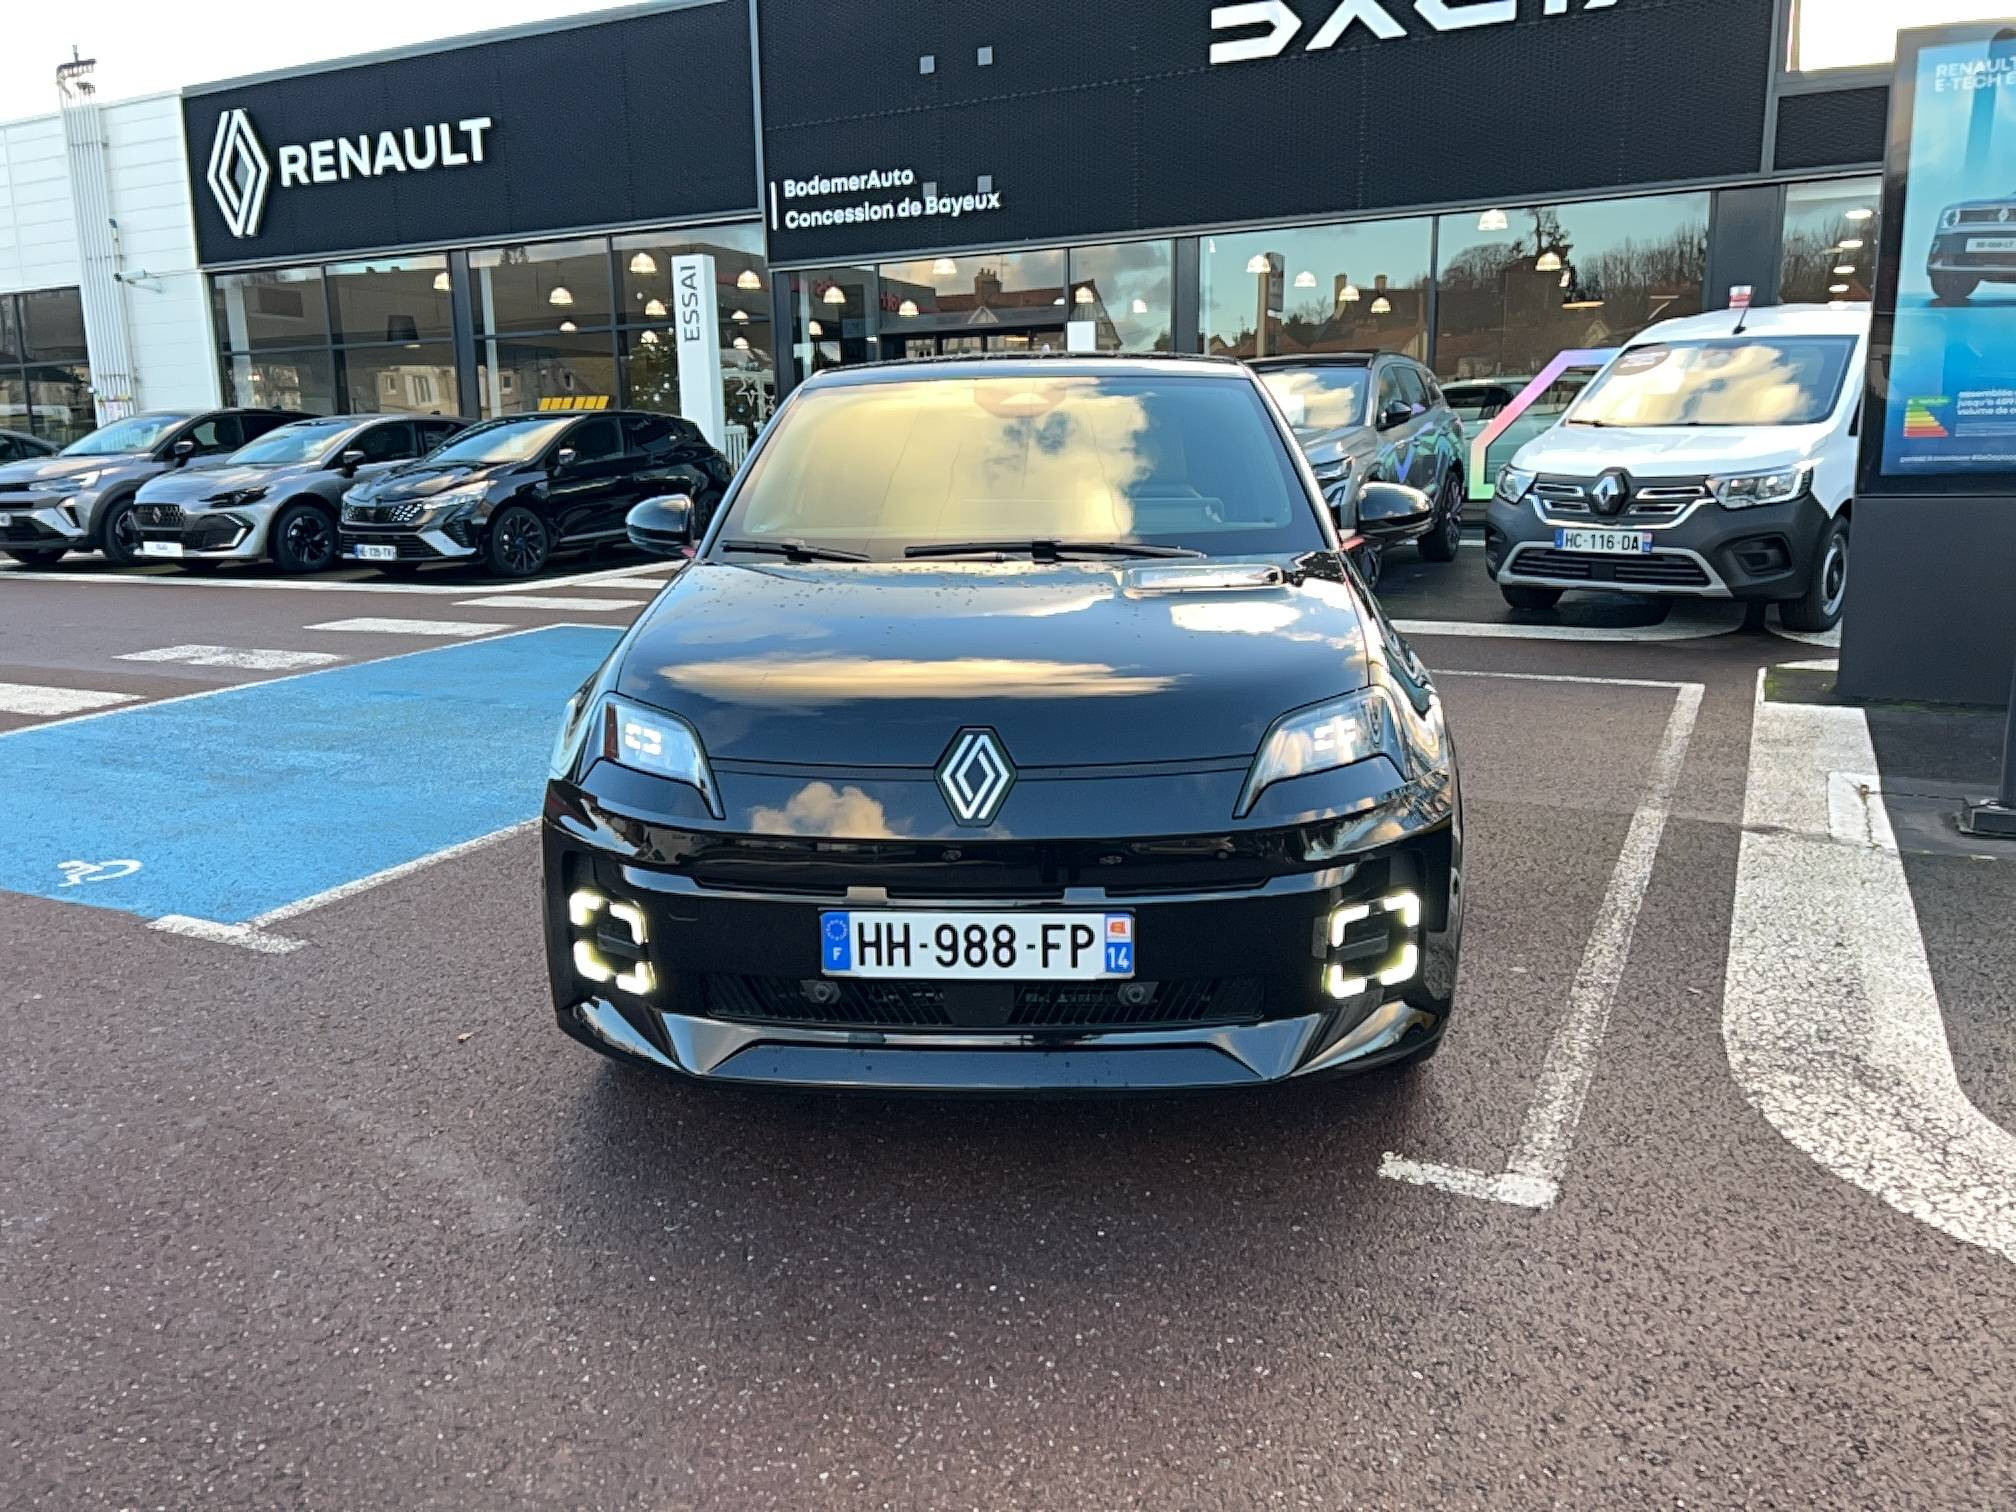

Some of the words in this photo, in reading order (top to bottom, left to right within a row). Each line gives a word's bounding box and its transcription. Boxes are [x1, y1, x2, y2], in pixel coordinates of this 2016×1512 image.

[279, 117, 492, 188] RENAULT
[783, 169, 914, 198] BodemerAuto
[785, 200, 894, 229] Concession
[897, 197, 922, 217] de
[924, 191, 1001, 217] Bayeux
[680, 265, 700, 342] ESSAI
[1565, 533, 1639, 551] HC-116-DA
[832, 947, 842, 961] F
[857, 922, 1096, 968] HH-988-FP
[1107, 946, 1130, 970] 14
